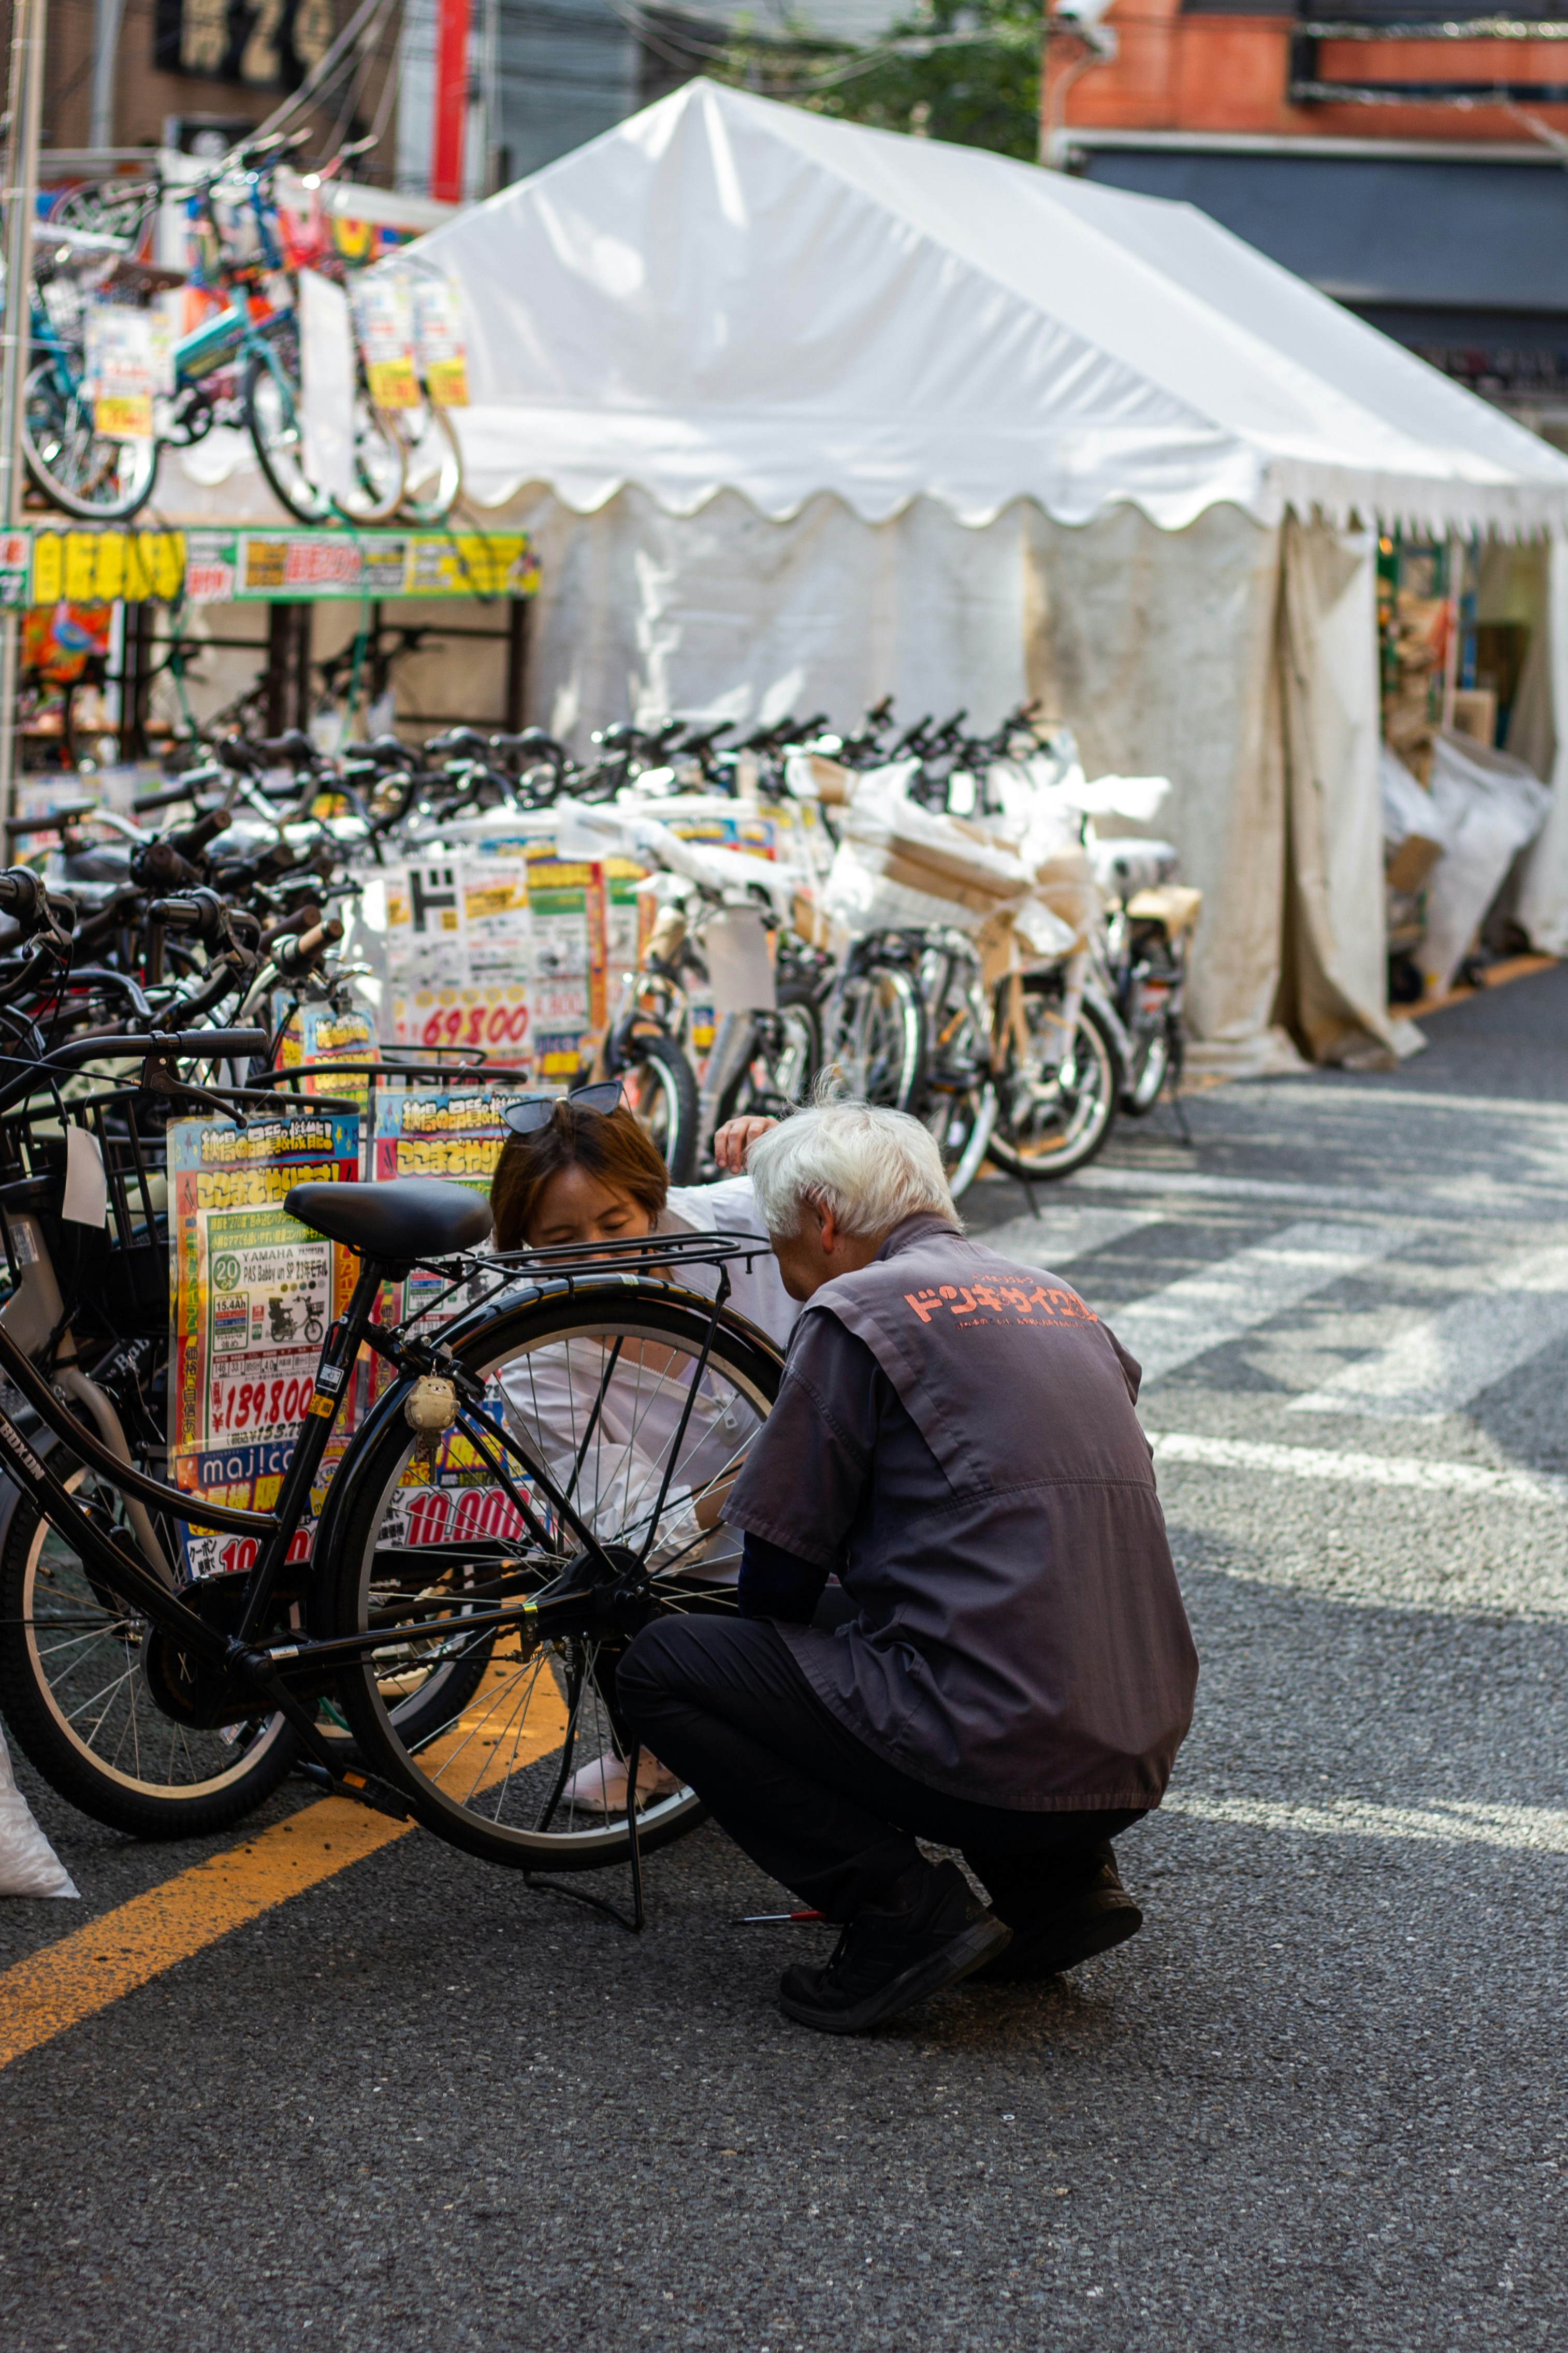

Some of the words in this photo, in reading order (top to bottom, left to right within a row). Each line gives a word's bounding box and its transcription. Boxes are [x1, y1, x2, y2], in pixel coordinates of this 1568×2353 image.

[243, 1248, 293, 1262] YAMAHA
[216, 1260, 238, 1280] 20
[244, 1265, 256, 1283] PAS
[258, 1264, 275, 1283] Babby
[216, 1300, 246, 1311] 15.4Ah
[215, 1363, 226, 1373] 146
